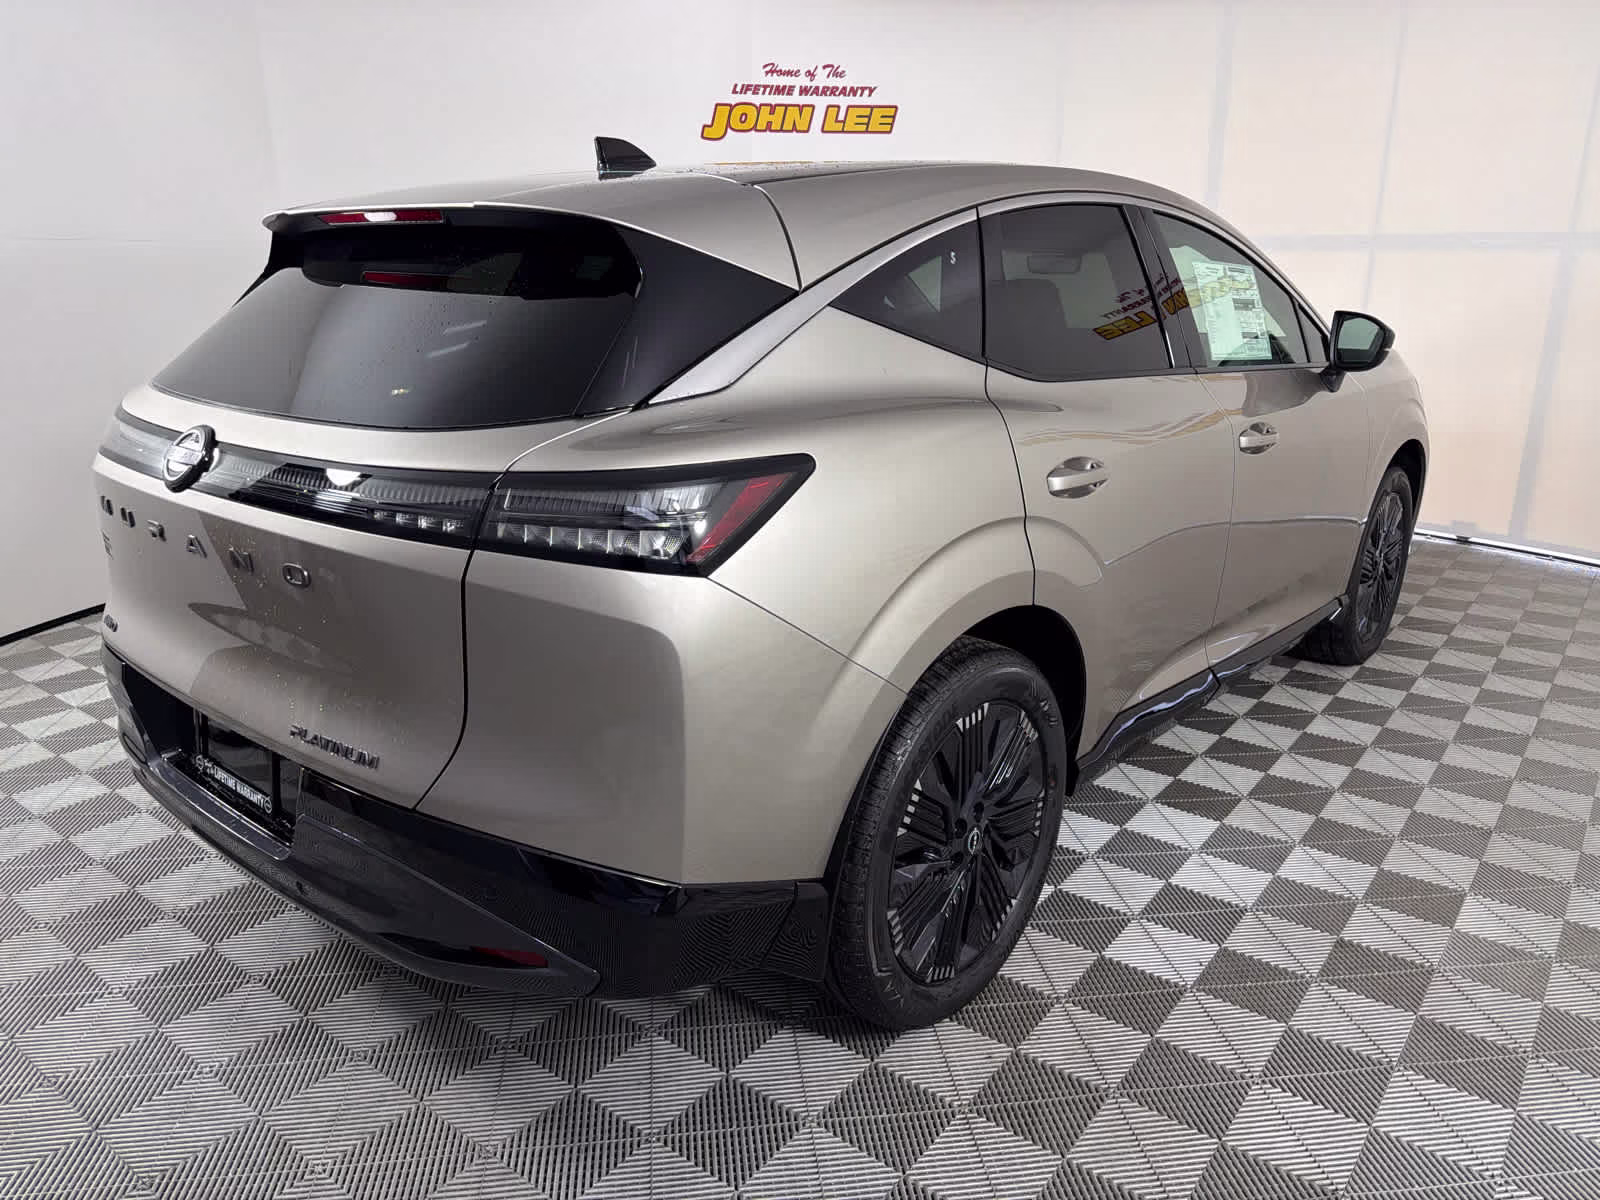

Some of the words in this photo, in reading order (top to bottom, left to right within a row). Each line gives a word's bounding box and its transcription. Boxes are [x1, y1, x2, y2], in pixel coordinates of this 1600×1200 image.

[731, 83, 796, 97] LIFETIME
[799, 85, 877, 98] WARRANTY
[762, 62, 801, 78] Home
[804, 65, 818, 82] of
[822, 63, 847, 79] The
[700, 102, 816, 141] JOHN
[821, 105, 898, 134] LEE
[290, 724, 381, 770] PLATINUM
[214, 765, 236, 791] LIFETIME
[236, 781, 265, 809] WARRANTY
